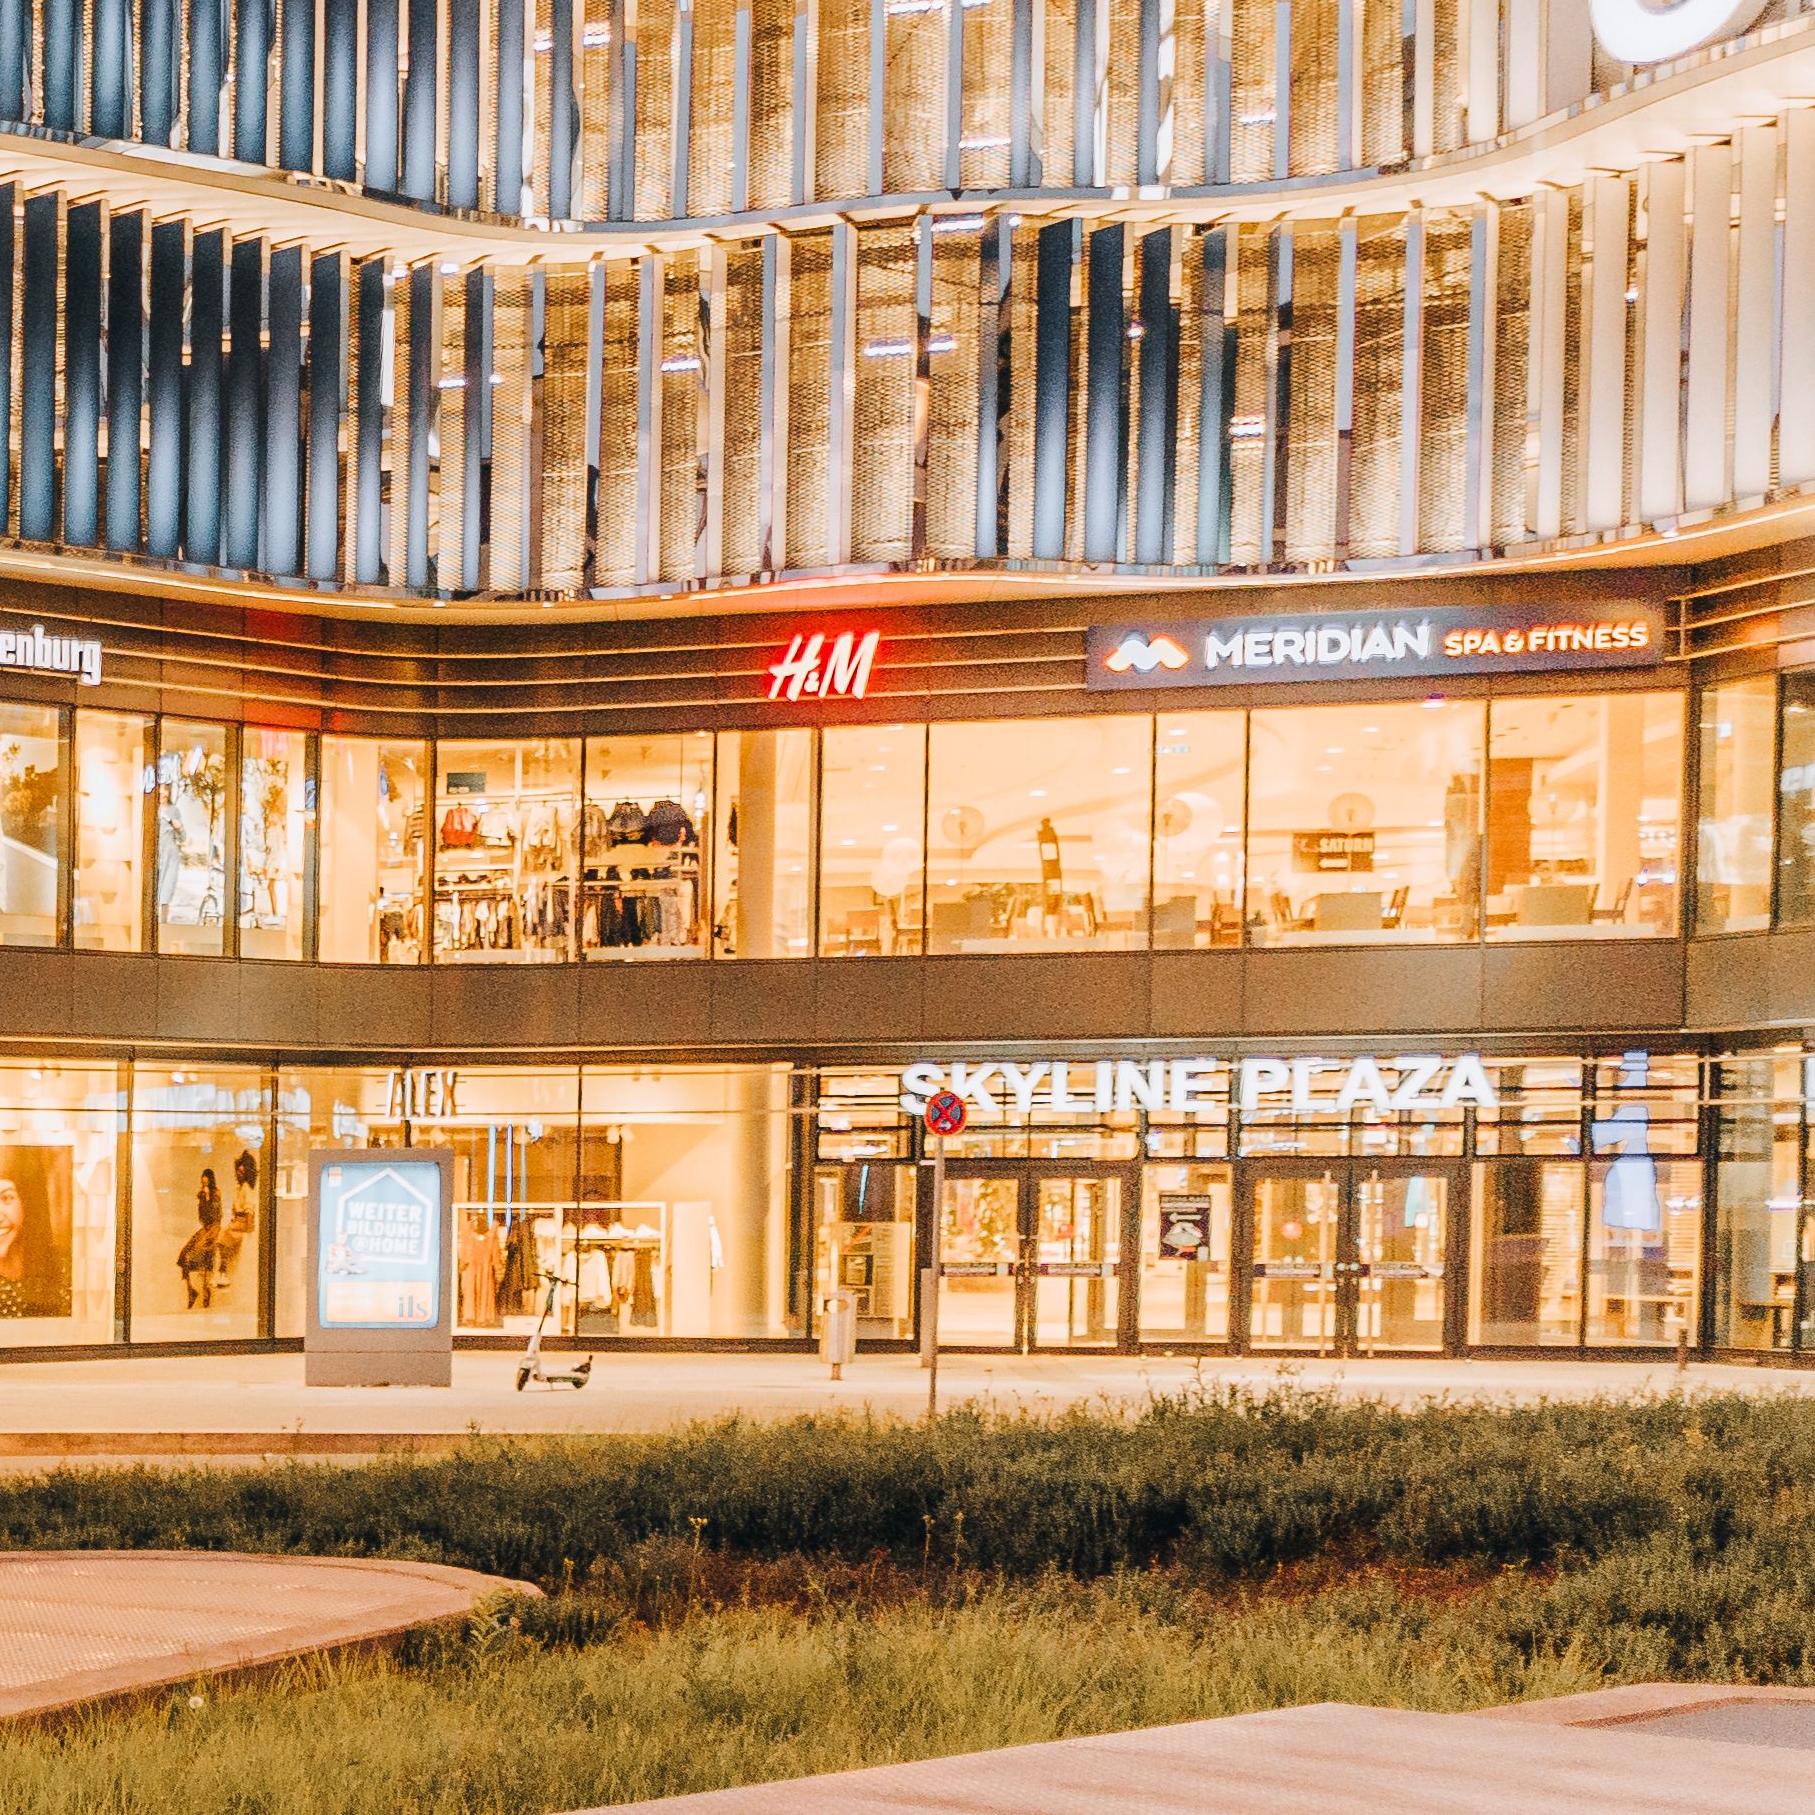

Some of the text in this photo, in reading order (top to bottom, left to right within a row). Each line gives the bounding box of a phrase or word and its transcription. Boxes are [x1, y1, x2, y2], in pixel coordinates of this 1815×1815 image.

[768, 630, 880, 701] H&M
[1204, 621, 1649, 669] MERIDIAN SPA & FITNESS
[1319, 837, 1374, 853] SATURN
[385, 1071, 458, 1118] ALEX
[899, 1054, 1500, 1115] SKYLINE PLAZA
[346, 1219, 421, 1238] BILDUNG
[348, 1201, 423, 1223] WEITER
